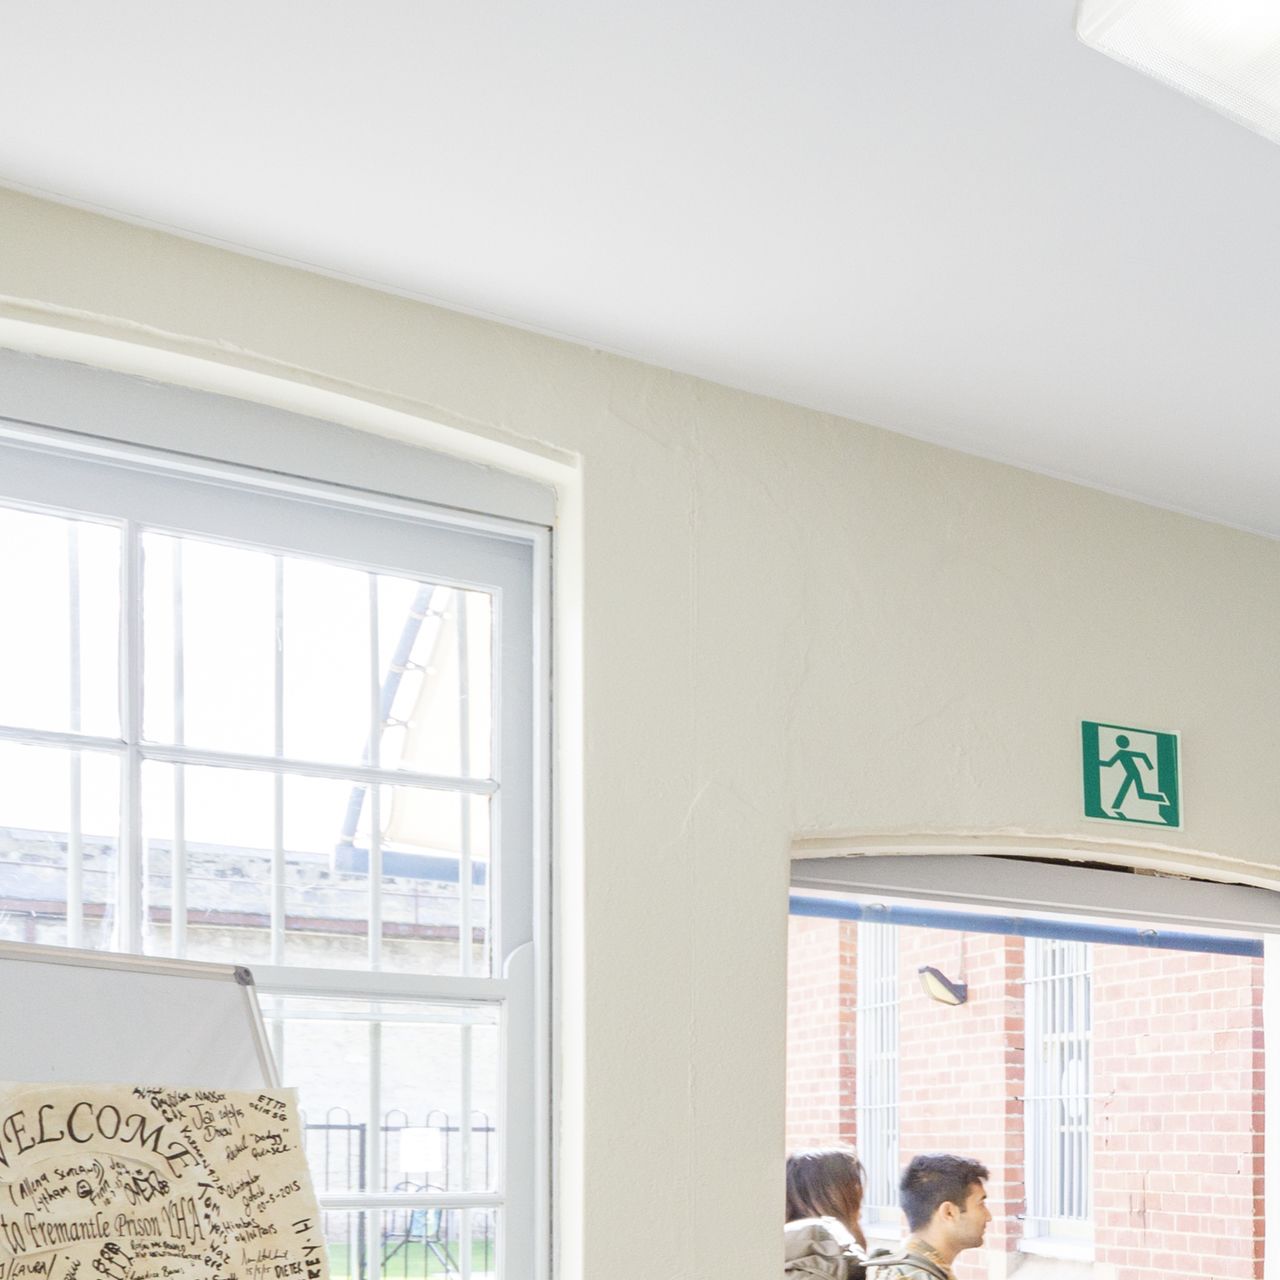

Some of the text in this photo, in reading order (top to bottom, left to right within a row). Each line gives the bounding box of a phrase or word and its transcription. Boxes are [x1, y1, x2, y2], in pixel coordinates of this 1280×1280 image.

[1, 1214, 26, 1255] to
[24, 1211, 110, 1249] Fremantle
[114, 1213, 162, 1237] Prison
[161, 1195, 206, 1246] YHA
